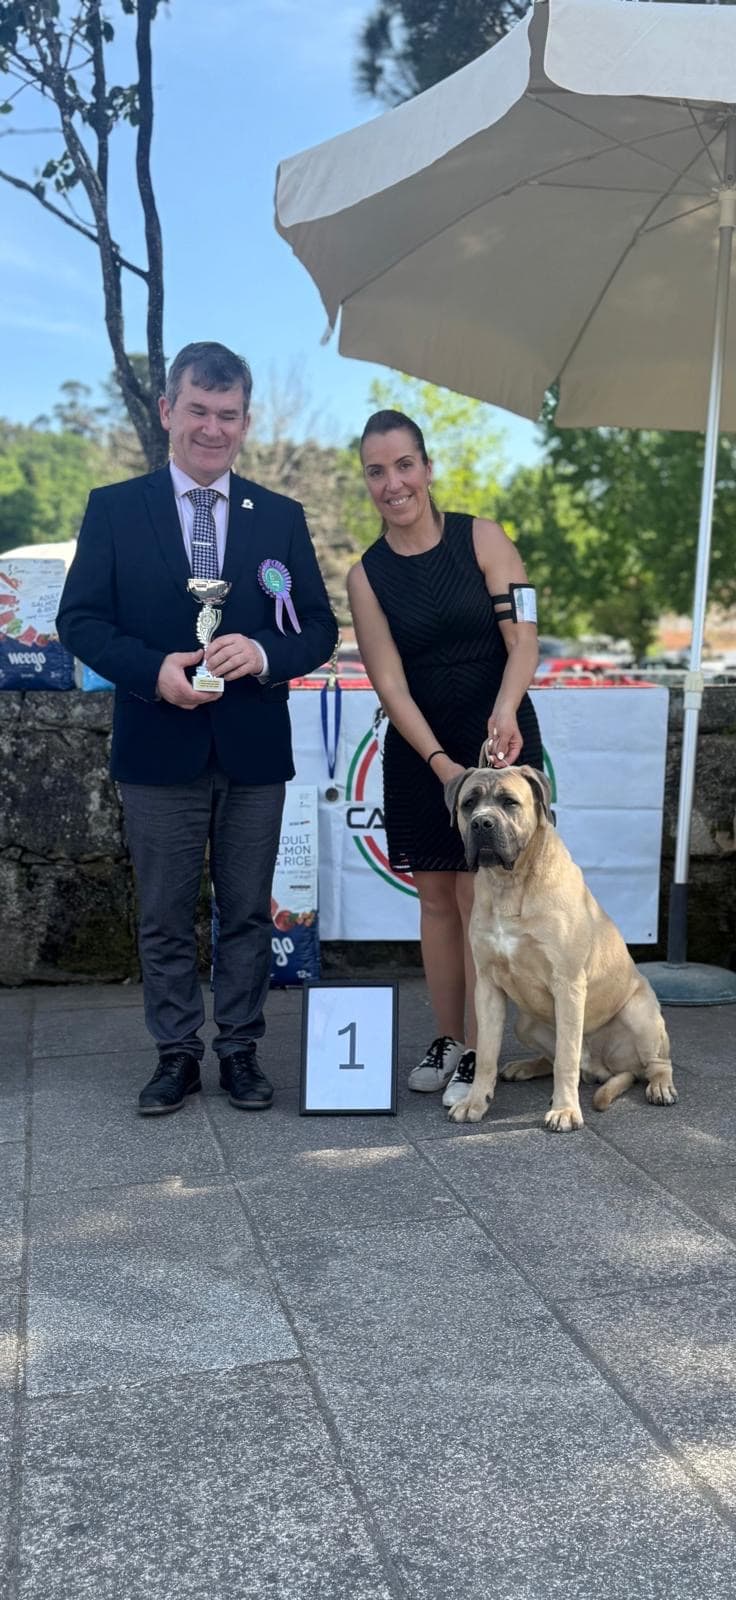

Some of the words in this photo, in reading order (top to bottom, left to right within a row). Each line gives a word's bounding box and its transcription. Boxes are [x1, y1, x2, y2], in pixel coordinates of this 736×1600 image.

[346, 807, 385, 829] CA
[280, 834, 311, 846] DULT
[277, 845, 311, 856] LMON
[284, 855, 312, 867] RICE
[271, 937, 295, 967] go
[337, 1021, 365, 1070] 1
